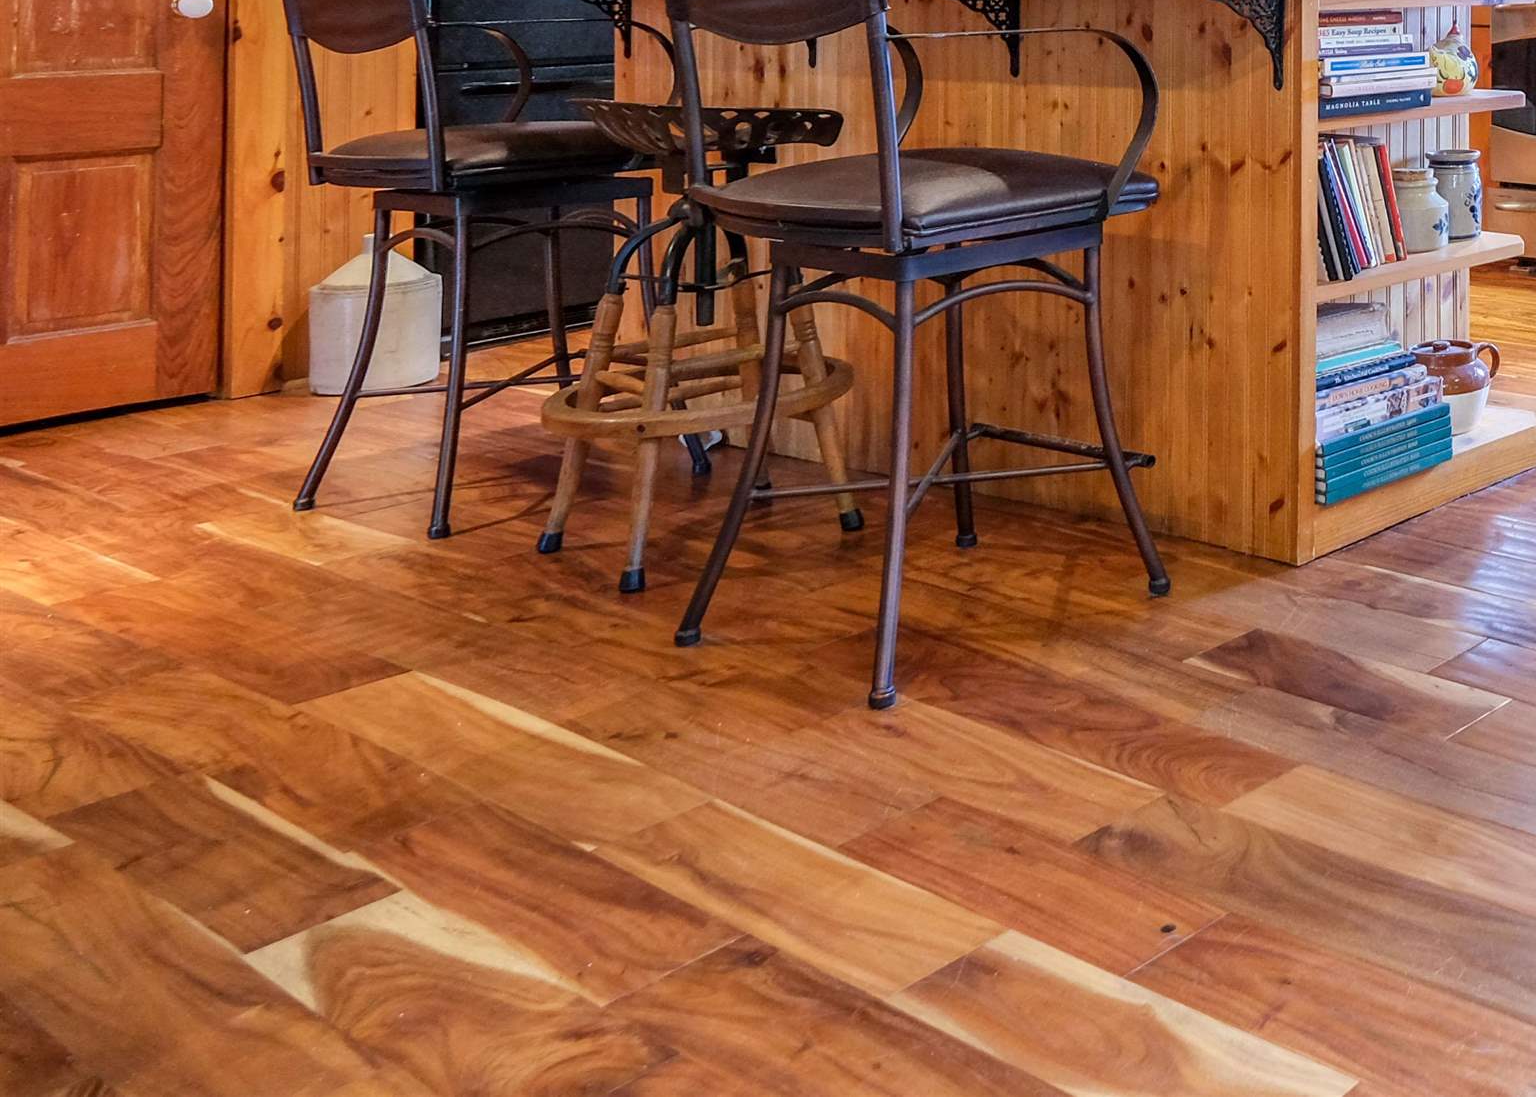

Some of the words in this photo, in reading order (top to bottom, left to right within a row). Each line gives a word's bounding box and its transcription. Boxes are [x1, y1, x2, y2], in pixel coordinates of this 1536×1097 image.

[1331, 28, 1345, 37] Easy
[1347, 28, 1362, 36] Soup
[1364, 27, 1386, 35] Recipes
[1325, 101, 1359, 110] MAGNOLIA
